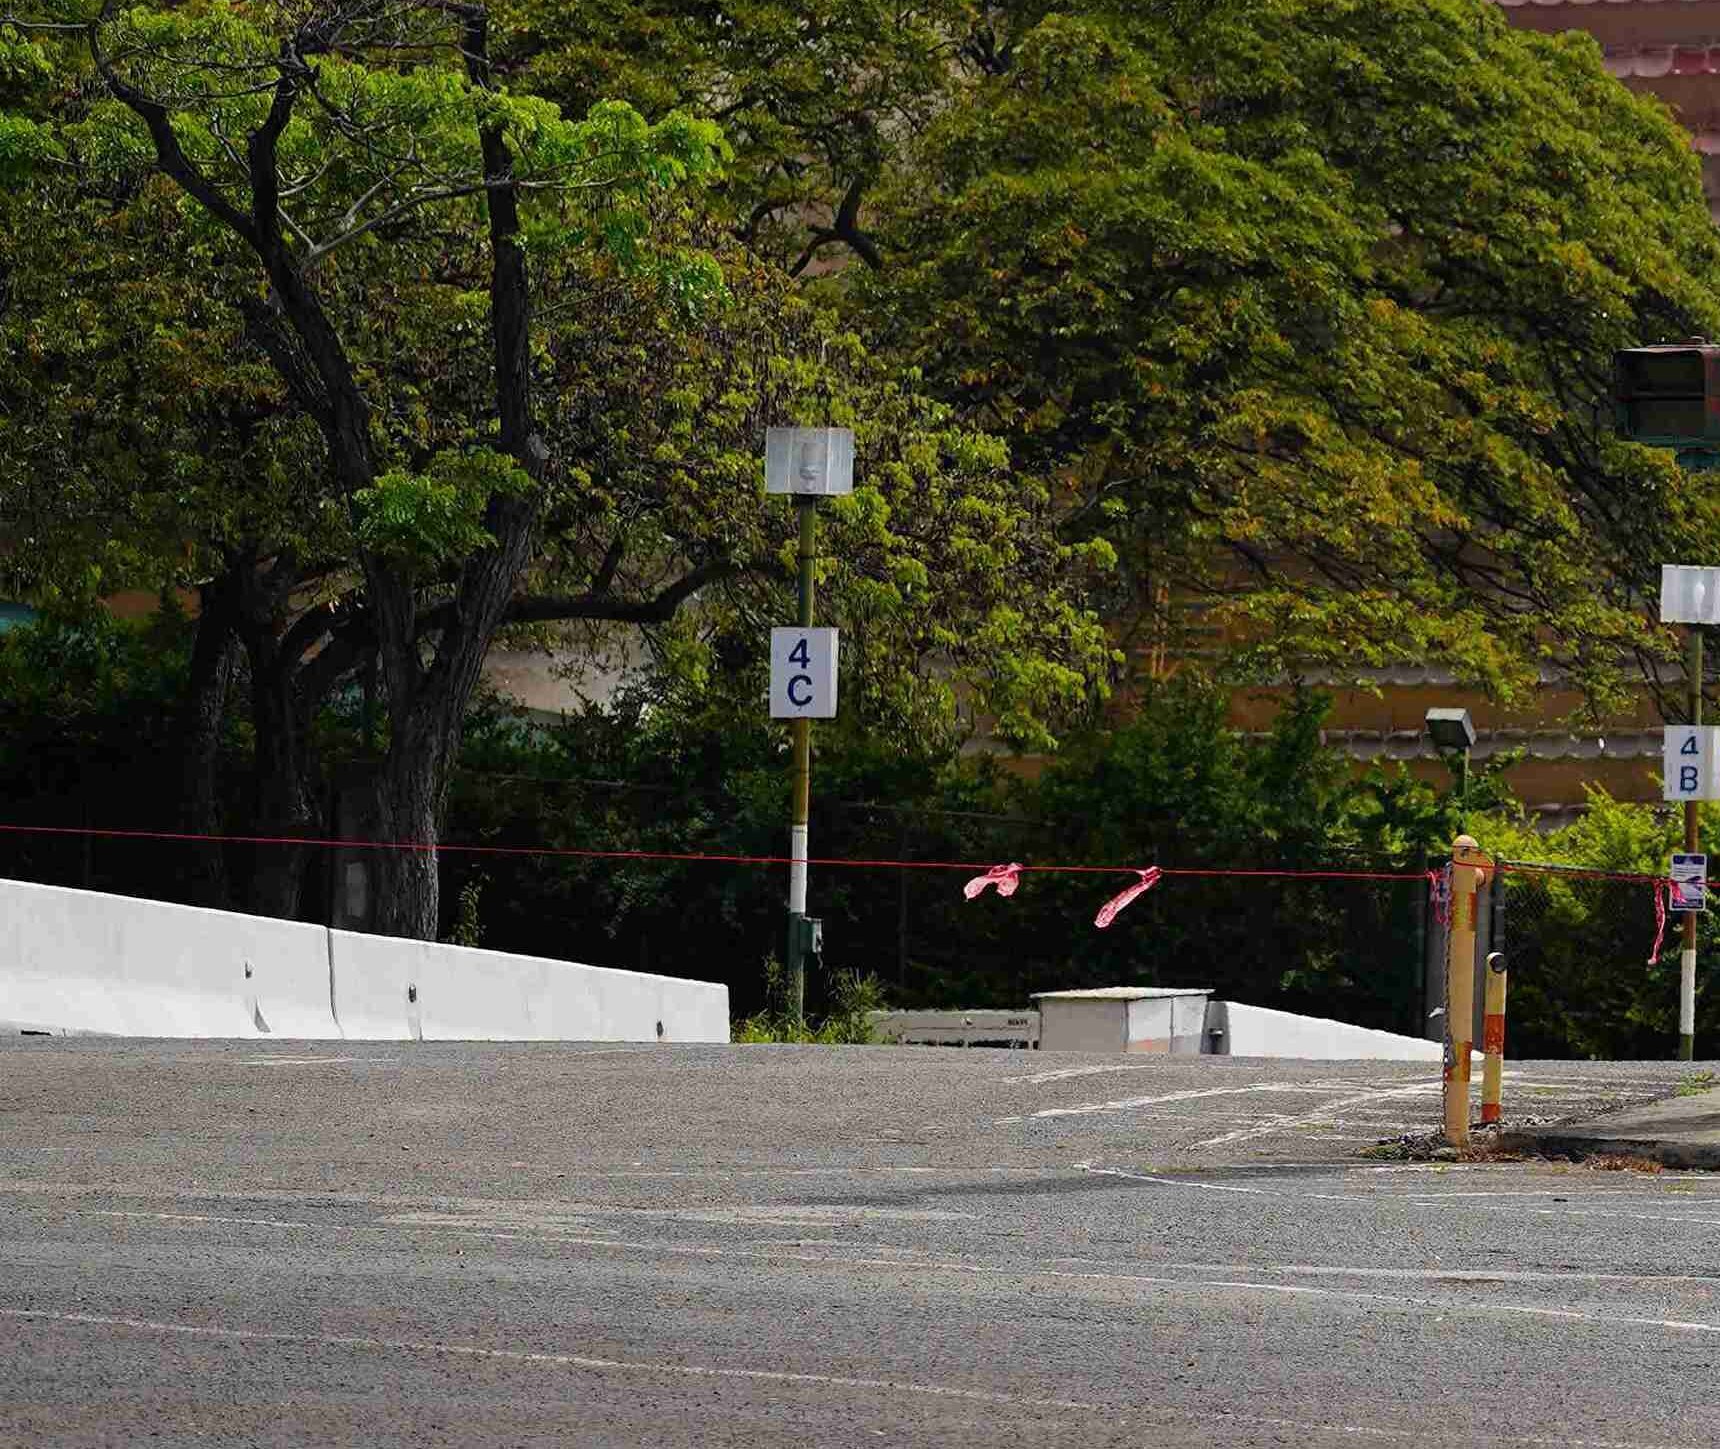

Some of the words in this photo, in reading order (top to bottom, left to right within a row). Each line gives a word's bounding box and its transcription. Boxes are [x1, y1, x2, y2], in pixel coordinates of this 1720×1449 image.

[788, 638, 811, 669] 4
[787, 674, 813, 706] C
[1680, 736, 1699, 755] 4
[1679, 765, 1699, 792] B
